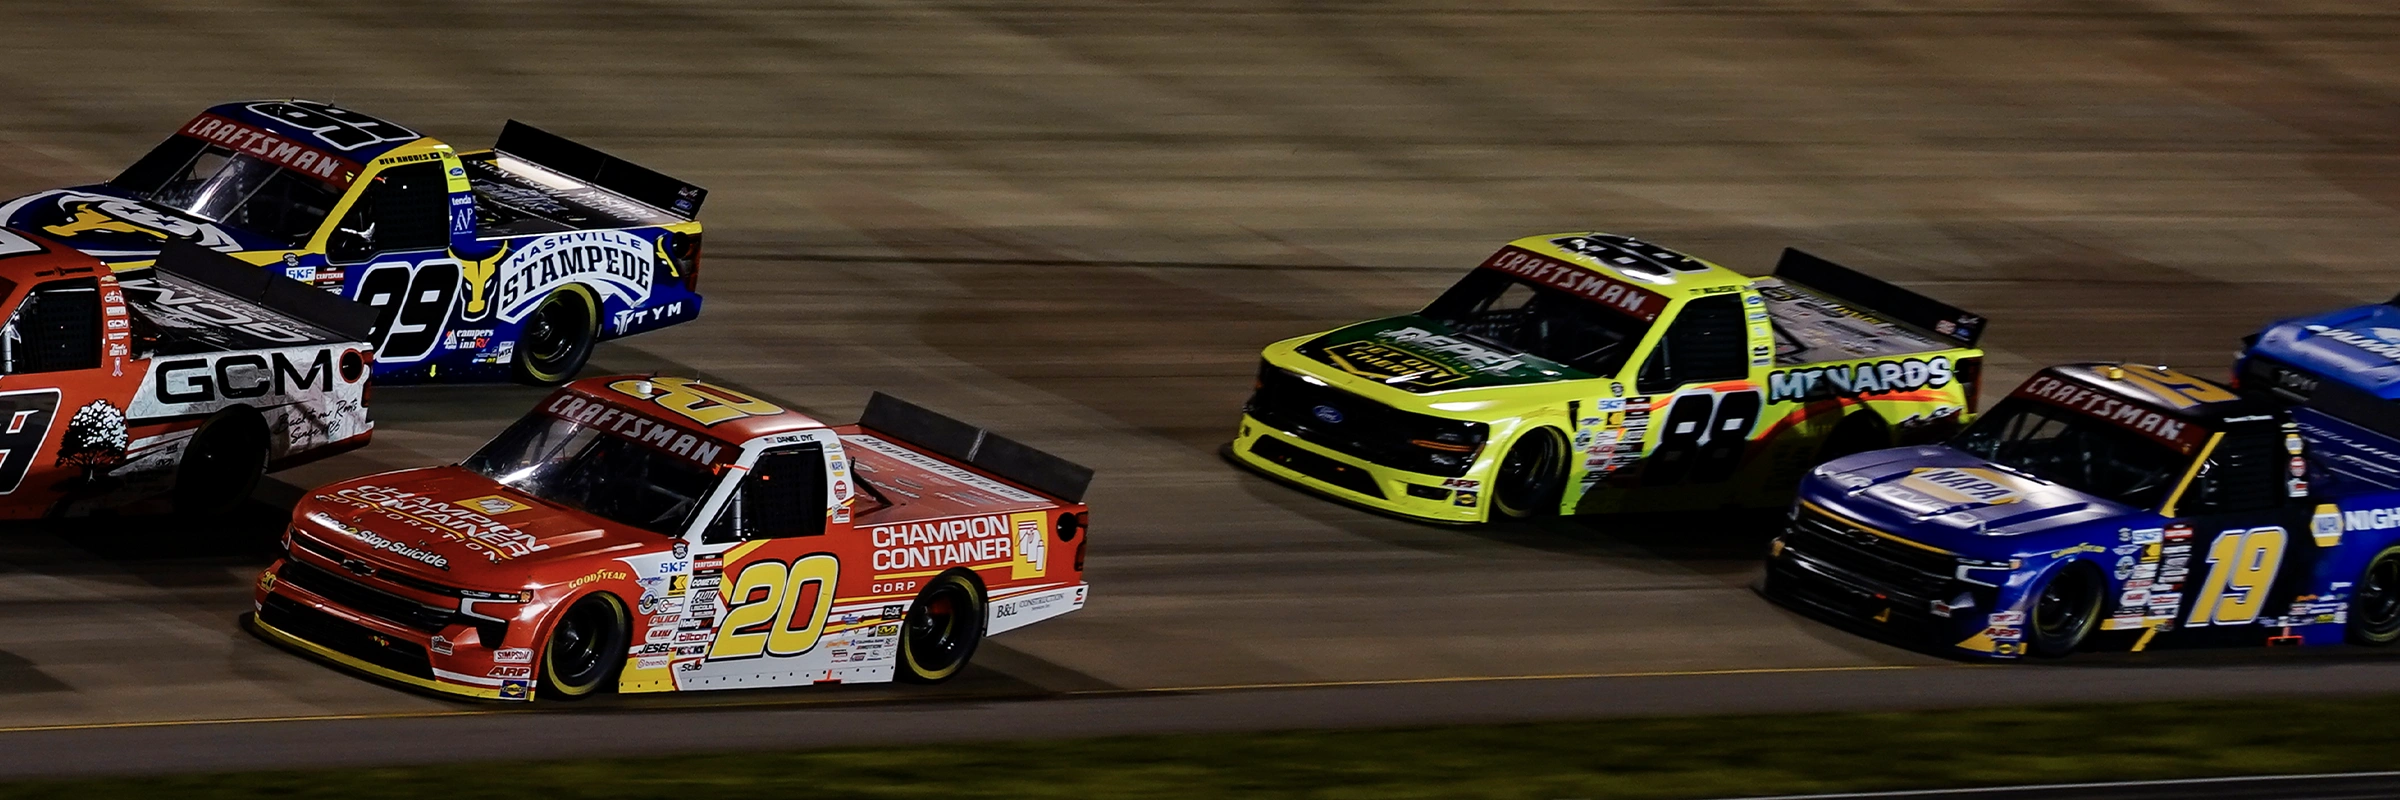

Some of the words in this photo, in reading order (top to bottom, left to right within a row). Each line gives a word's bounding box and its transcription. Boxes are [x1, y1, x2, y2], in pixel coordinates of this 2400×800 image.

[187, 116, 341, 178] CRAFTSMAN
[378, 157, 396, 165] BEN
[396, 153, 429, 163] RHODES
[513, 229, 642, 267] NASHVILLE
[288, 268, 314, 279] SKF
[502, 244, 650, 309] STAMPEDE
[1493, 252, 1648, 311] CRAFTSMAN
[352, 259, 462, 363] 99
[634, 301, 682, 325] TYM
[456, 329, 494, 340] campers
[155, 348, 334, 404] GCM
[1768, 356, 1954, 406] MENARDS
[607, 375, 786, 427] 20
[2025, 376, 2187, 441] CRAFTSMAN
[547, 394, 722, 466] CRAFTSMAN
[776, 435, 800, 443] DANIEL
[801, 433, 814, 442] DYE
[1640, 388, 1764, 487] 88
[1921, 467, 2012, 499] NAPA
[315, 494, 503, 564] CORPORATION
[337, 488, 531, 558] CONTAINER
[357, 484, 551, 553] CHAMPION
[872, 514, 1010, 548] CHAMPION
[360, 529, 389, 550] Stop
[388, 540, 451, 570] Suicide
[660, 561, 688, 573] SKF
[872, 537, 1012, 571] CONTAINER
[568, 567, 627, 589] GOODYEAR
[691, 577, 721, 587] COMETIC
[872, 580, 917, 594] CORP
[2184, 525, 2289, 628] 19
[706, 553, 840, 662] 20
[996, 602, 1018, 619] B&L
[497, 651, 530, 660] SIMPSON
[639, 643, 671, 654] JESEL
[489, 666, 530, 676] ARP
